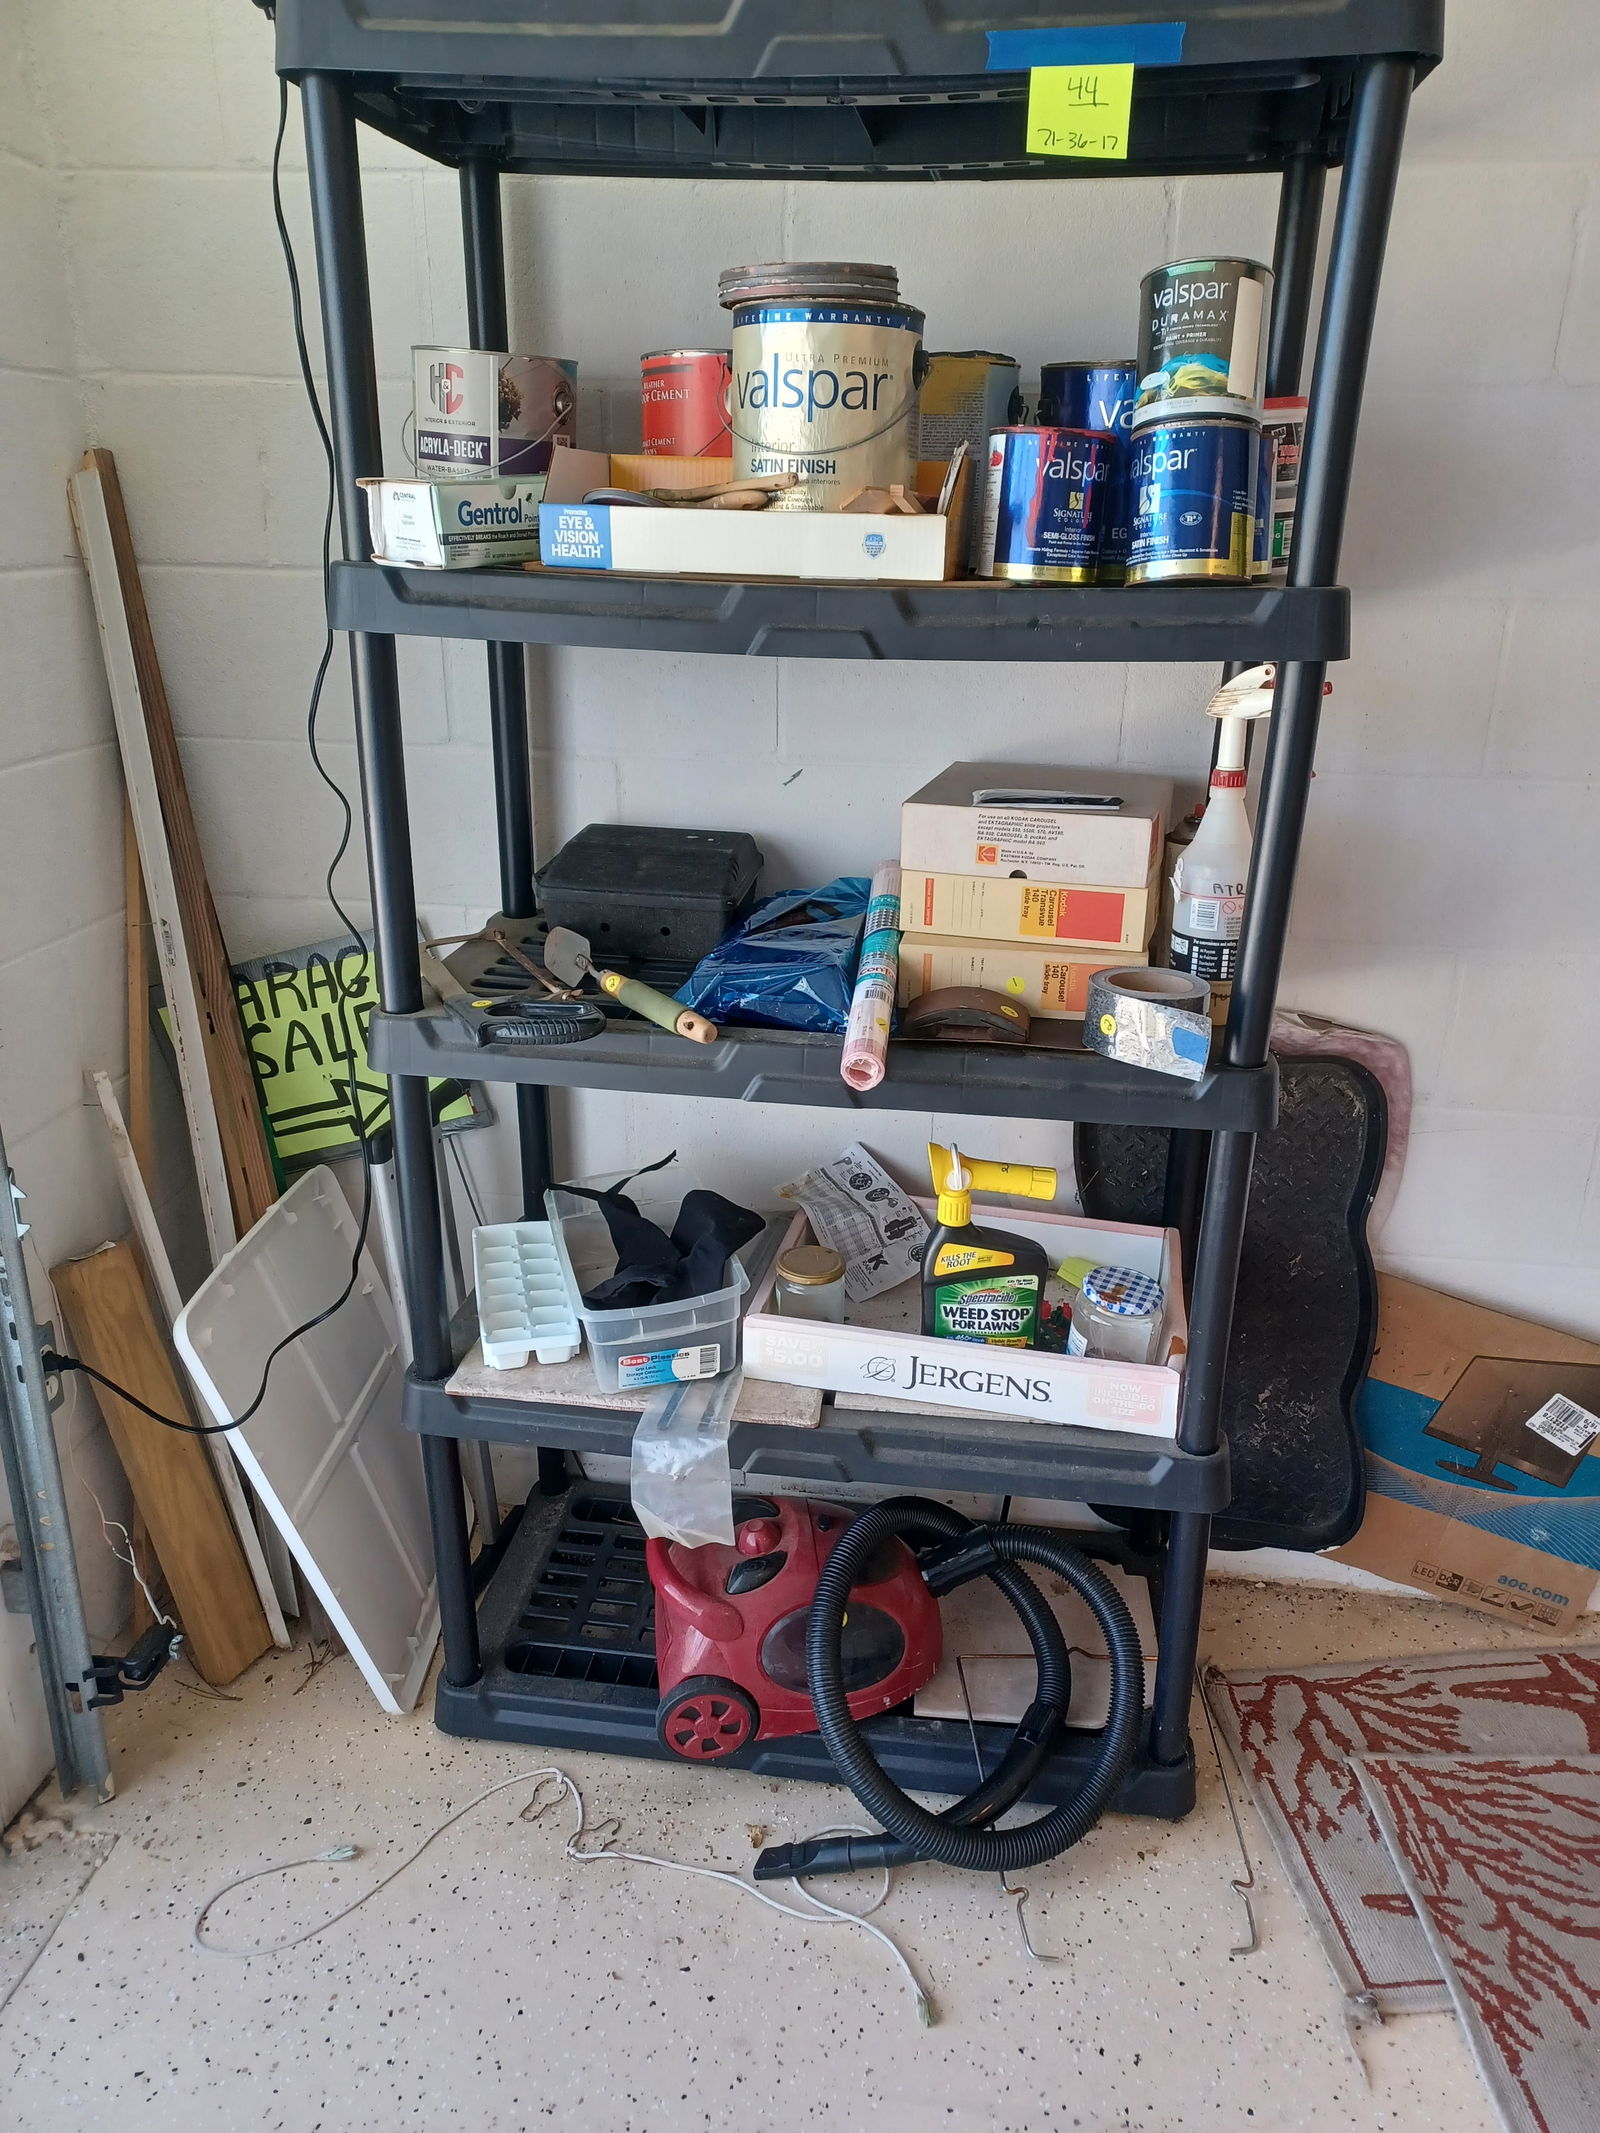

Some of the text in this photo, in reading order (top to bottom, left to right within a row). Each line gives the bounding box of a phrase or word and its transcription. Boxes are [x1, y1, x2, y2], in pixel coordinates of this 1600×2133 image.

[1068, 76, 1099, 106] 44
[1037, 129, 1119, 151] 71-36-17
[1154, 279, 1229, 309] valspar
[737, 312, 891, 325] LIFETIME WARRANTY
[1152, 310, 1226, 331] DURAMAX
[1166, 334, 1180, 342] PAINT
[785, 352, 889, 367] ULTRA PREMIUM
[738, 352, 888, 423] valspar
[651, 389, 690, 402] CEMENT
[751, 438, 795, 453] Interior
[750, 458, 836, 474] SATIN FINISH
[1036, 451, 1110, 487] valspar
[458, 498, 521, 526] Gentrol
[559, 516, 595, 530] EYE &
[554, 530, 599, 544] VISION
[1043, 532, 1080, 541] SEMI-GLOSS
[1146, 536, 1169, 546] FINISH
[1032, 889, 1040, 903] 140
[1060, 890, 1069, 917] Kodak
[1022, 905, 1030, 918] tray
[1039, 889, 1049, 926] Transvue
[1048, 890, 1057, 926] Carousel
[1043, 964, 1051, 980] slide
[1051, 965, 1059, 979] 140
[232, 945, 381, 1021] ARAG
[1058, 965, 1068, 1002] Carousel
[941, 1254, 960, 1262] KILLS
[946, 1258, 971, 1269] ROOT
[960, 1292, 1016, 1306] Spectracide
[943, 1306, 1029, 1321] WEED STOP
[952, 1320, 1020, 1331] FOR LAWNS
[766, 1334, 809, 1353] SAVE
[622, 1352, 690, 1367] Best Plastics
[766, 1347, 823, 1369] $5.00
[902, 1356, 1052, 1402] JERGENS
[1110, 1382, 1141, 1392] NOW
[1095, 1396, 1155, 1411] ON-THE-GO
[1112, 1408, 1136, 1417] SIZE
[1414, 1564, 1437, 1579] LED
[1439, 1573, 1460, 1587] DCR
[1497, 1575, 1569, 1606] aoc.com
